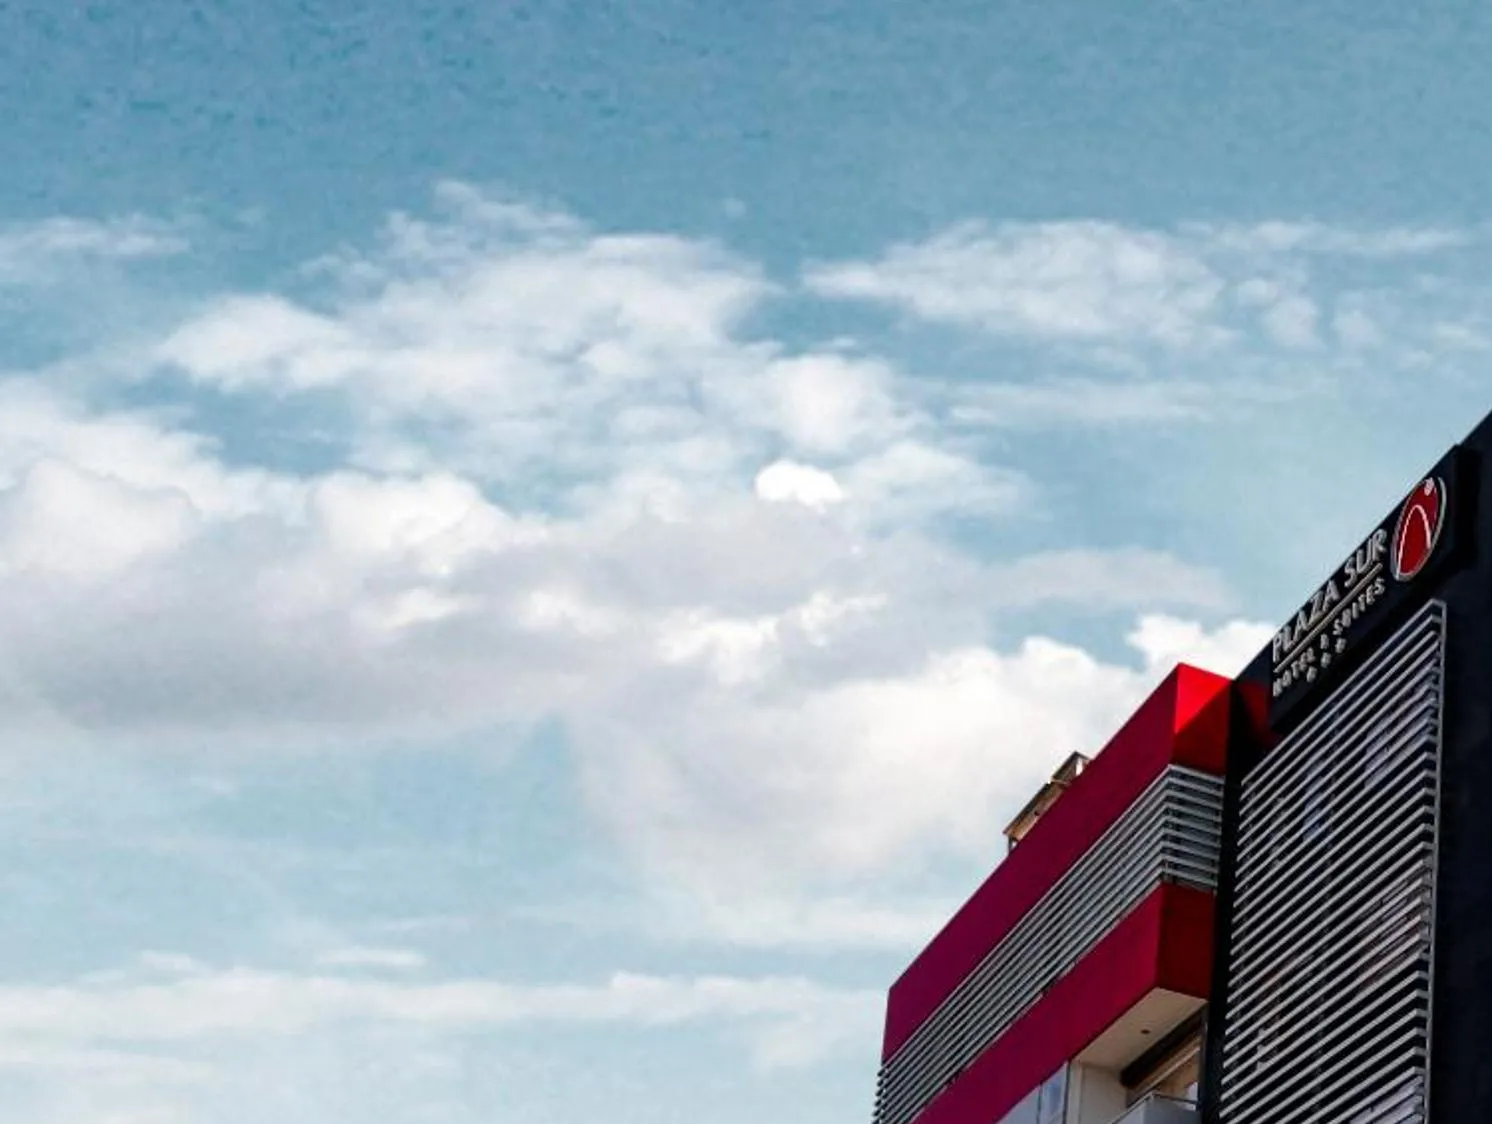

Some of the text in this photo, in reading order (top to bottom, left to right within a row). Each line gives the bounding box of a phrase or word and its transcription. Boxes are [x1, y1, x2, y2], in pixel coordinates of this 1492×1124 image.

[1272, 529, 1387, 663] PLAZA SUR
[1272, 647, 1316, 697] HOTEL
[1332, 577, 1386, 635] SUITES
